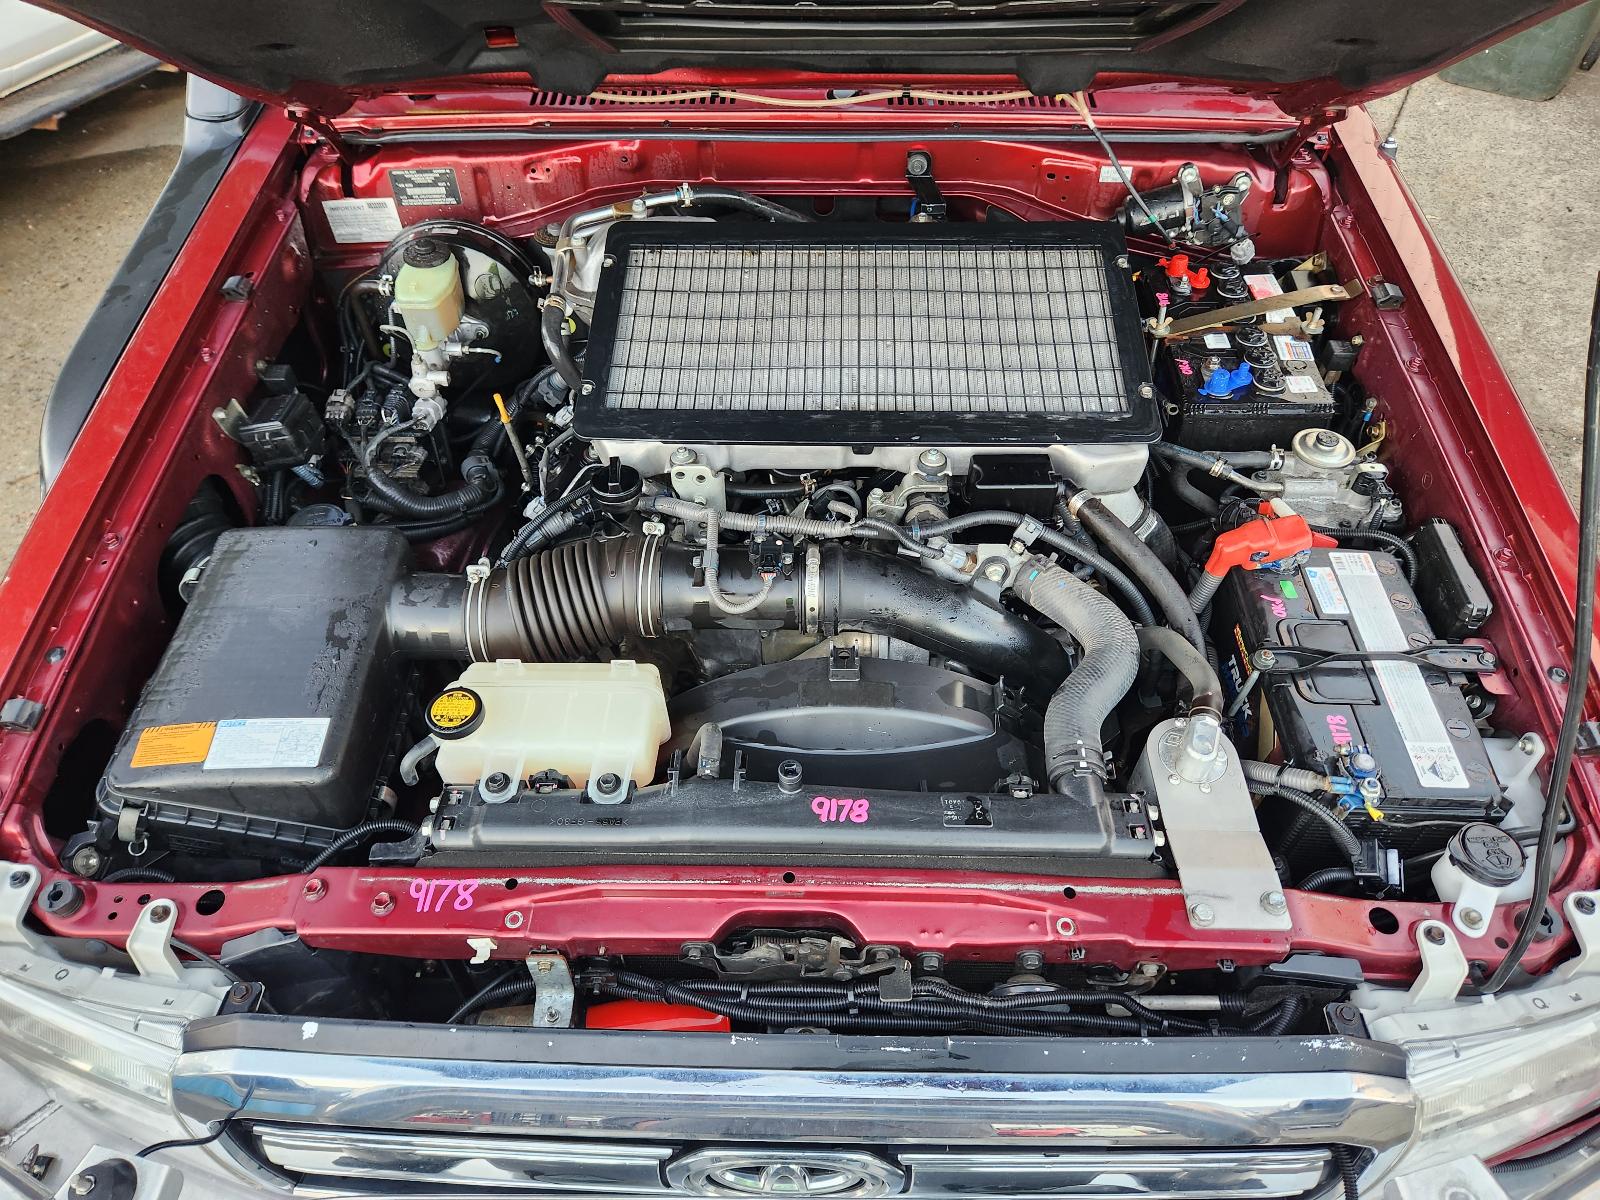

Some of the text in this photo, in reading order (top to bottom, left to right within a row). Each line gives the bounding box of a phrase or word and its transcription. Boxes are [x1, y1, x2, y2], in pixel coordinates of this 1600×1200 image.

[1228, 654, 1253, 720] TRUK
[1326, 714, 1353, 745] 9178
[811, 796, 870, 823] 9178
[408, 877, 480, 912] 9178
